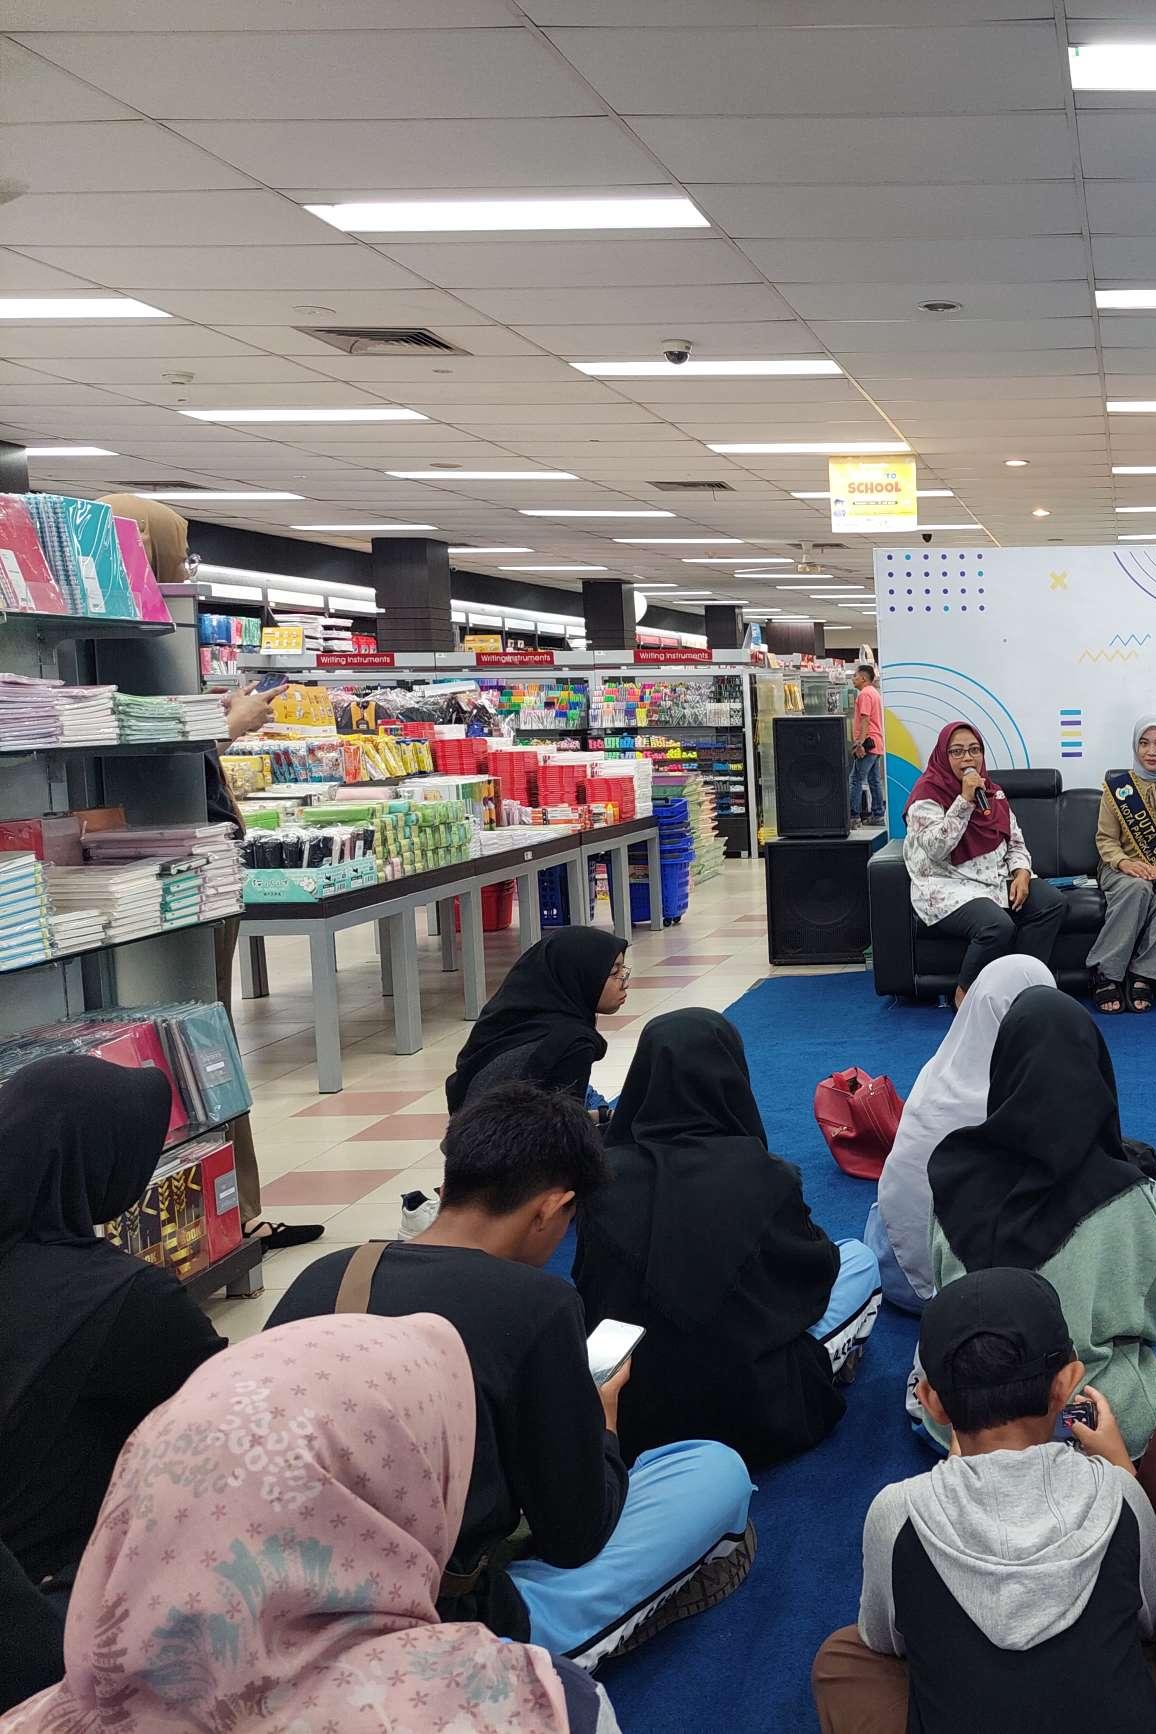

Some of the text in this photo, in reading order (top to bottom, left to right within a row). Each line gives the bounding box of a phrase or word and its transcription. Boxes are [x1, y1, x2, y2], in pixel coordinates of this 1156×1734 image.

[848, 481, 902, 494] SCHOOL
[320, 655, 391, 665] Writing Instruments
[480, 653, 551, 663] Writing Instruments
[639, 651, 709, 660] Writing Instruments
[1120, 803, 1136, 826] KOTA
